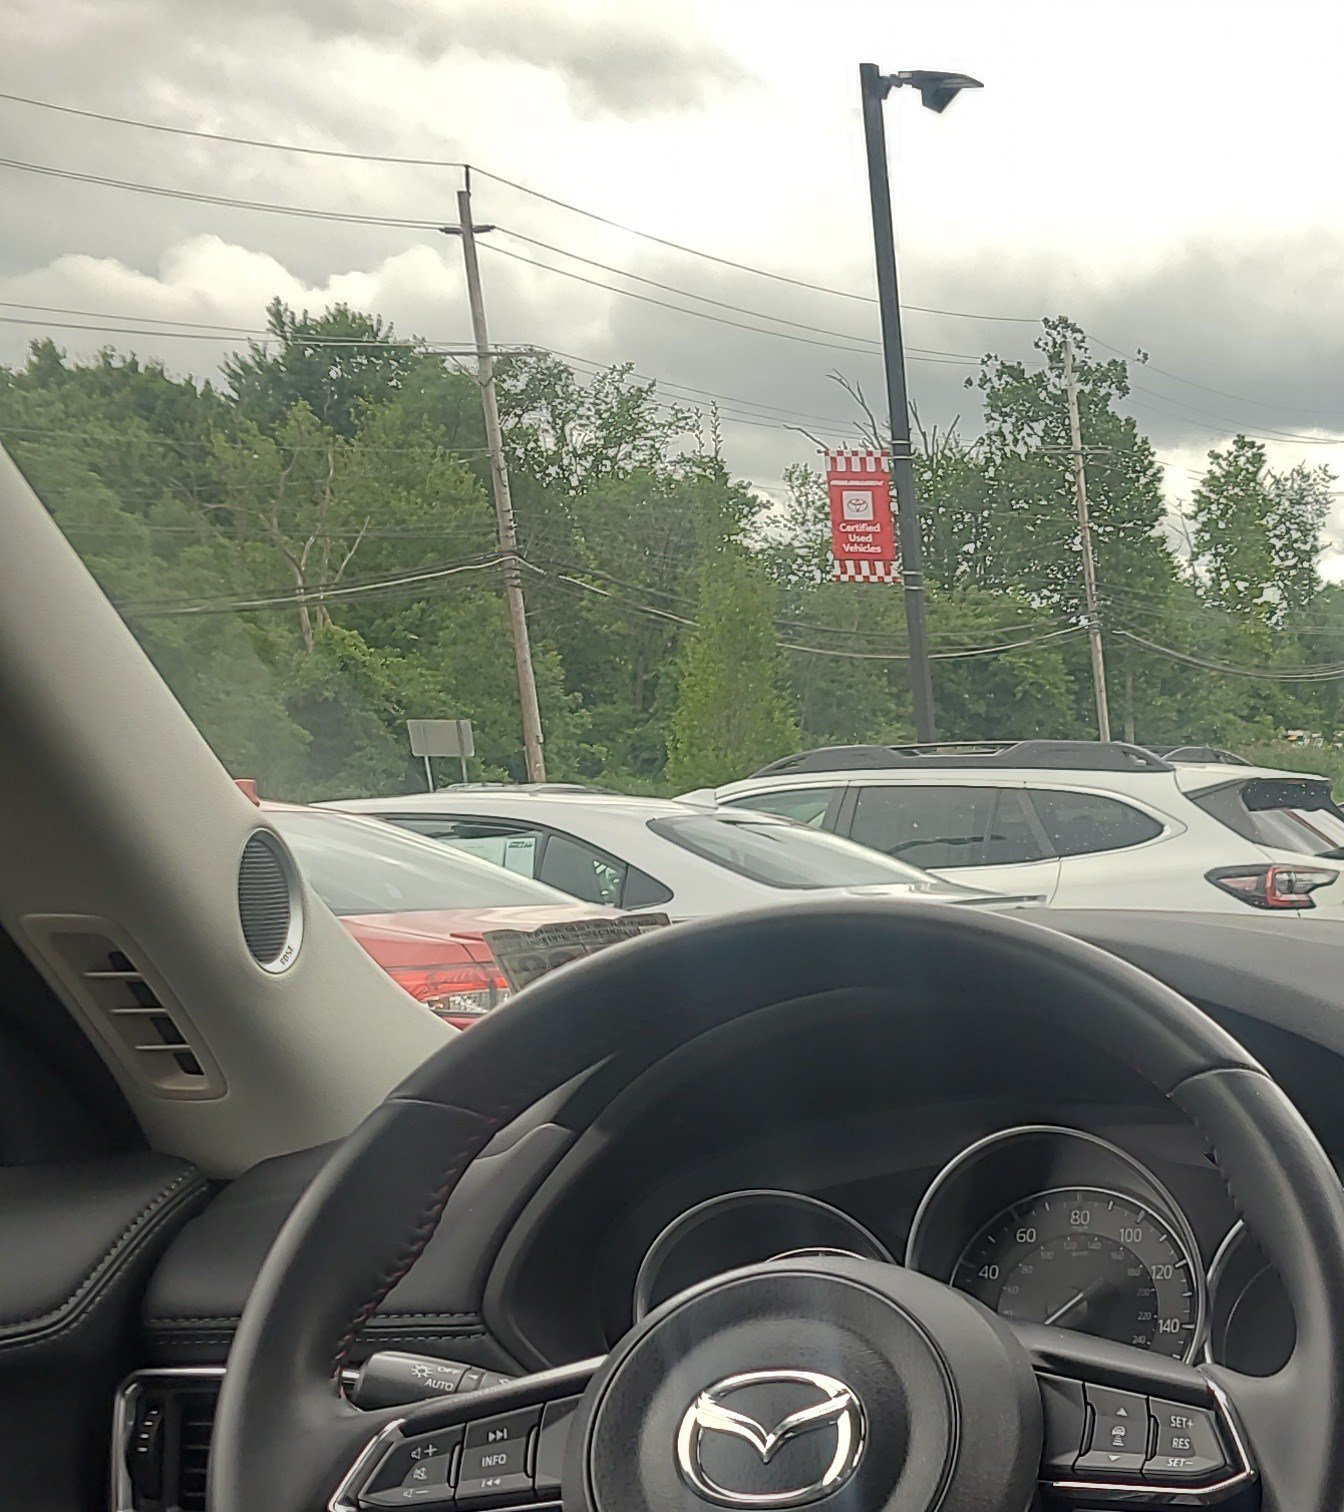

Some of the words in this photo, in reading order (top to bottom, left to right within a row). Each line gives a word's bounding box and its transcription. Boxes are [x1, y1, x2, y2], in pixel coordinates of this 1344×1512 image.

[840, 523, 880, 533] Certified
[848, 534, 873, 542] Used
[843, 544, 881, 553] Vehicles
[1070, 1211, 1090, 1225] 80
[1016, 1228, 1036, 1242] 60
[1119, 1228, 1142, 1242] 100
[978, 1265, 999, 1279] 40
[1151, 1265, 1172, 1279] 120
[1158, 1319, 1179, 1333] 140
[424, 1378, 454, 1391] AUTO
[1170, 1415, 1194, 1428] SET+
[1172, 1437, 1190, 1449] RES
[482, 1454, 507, 1467] INFO
